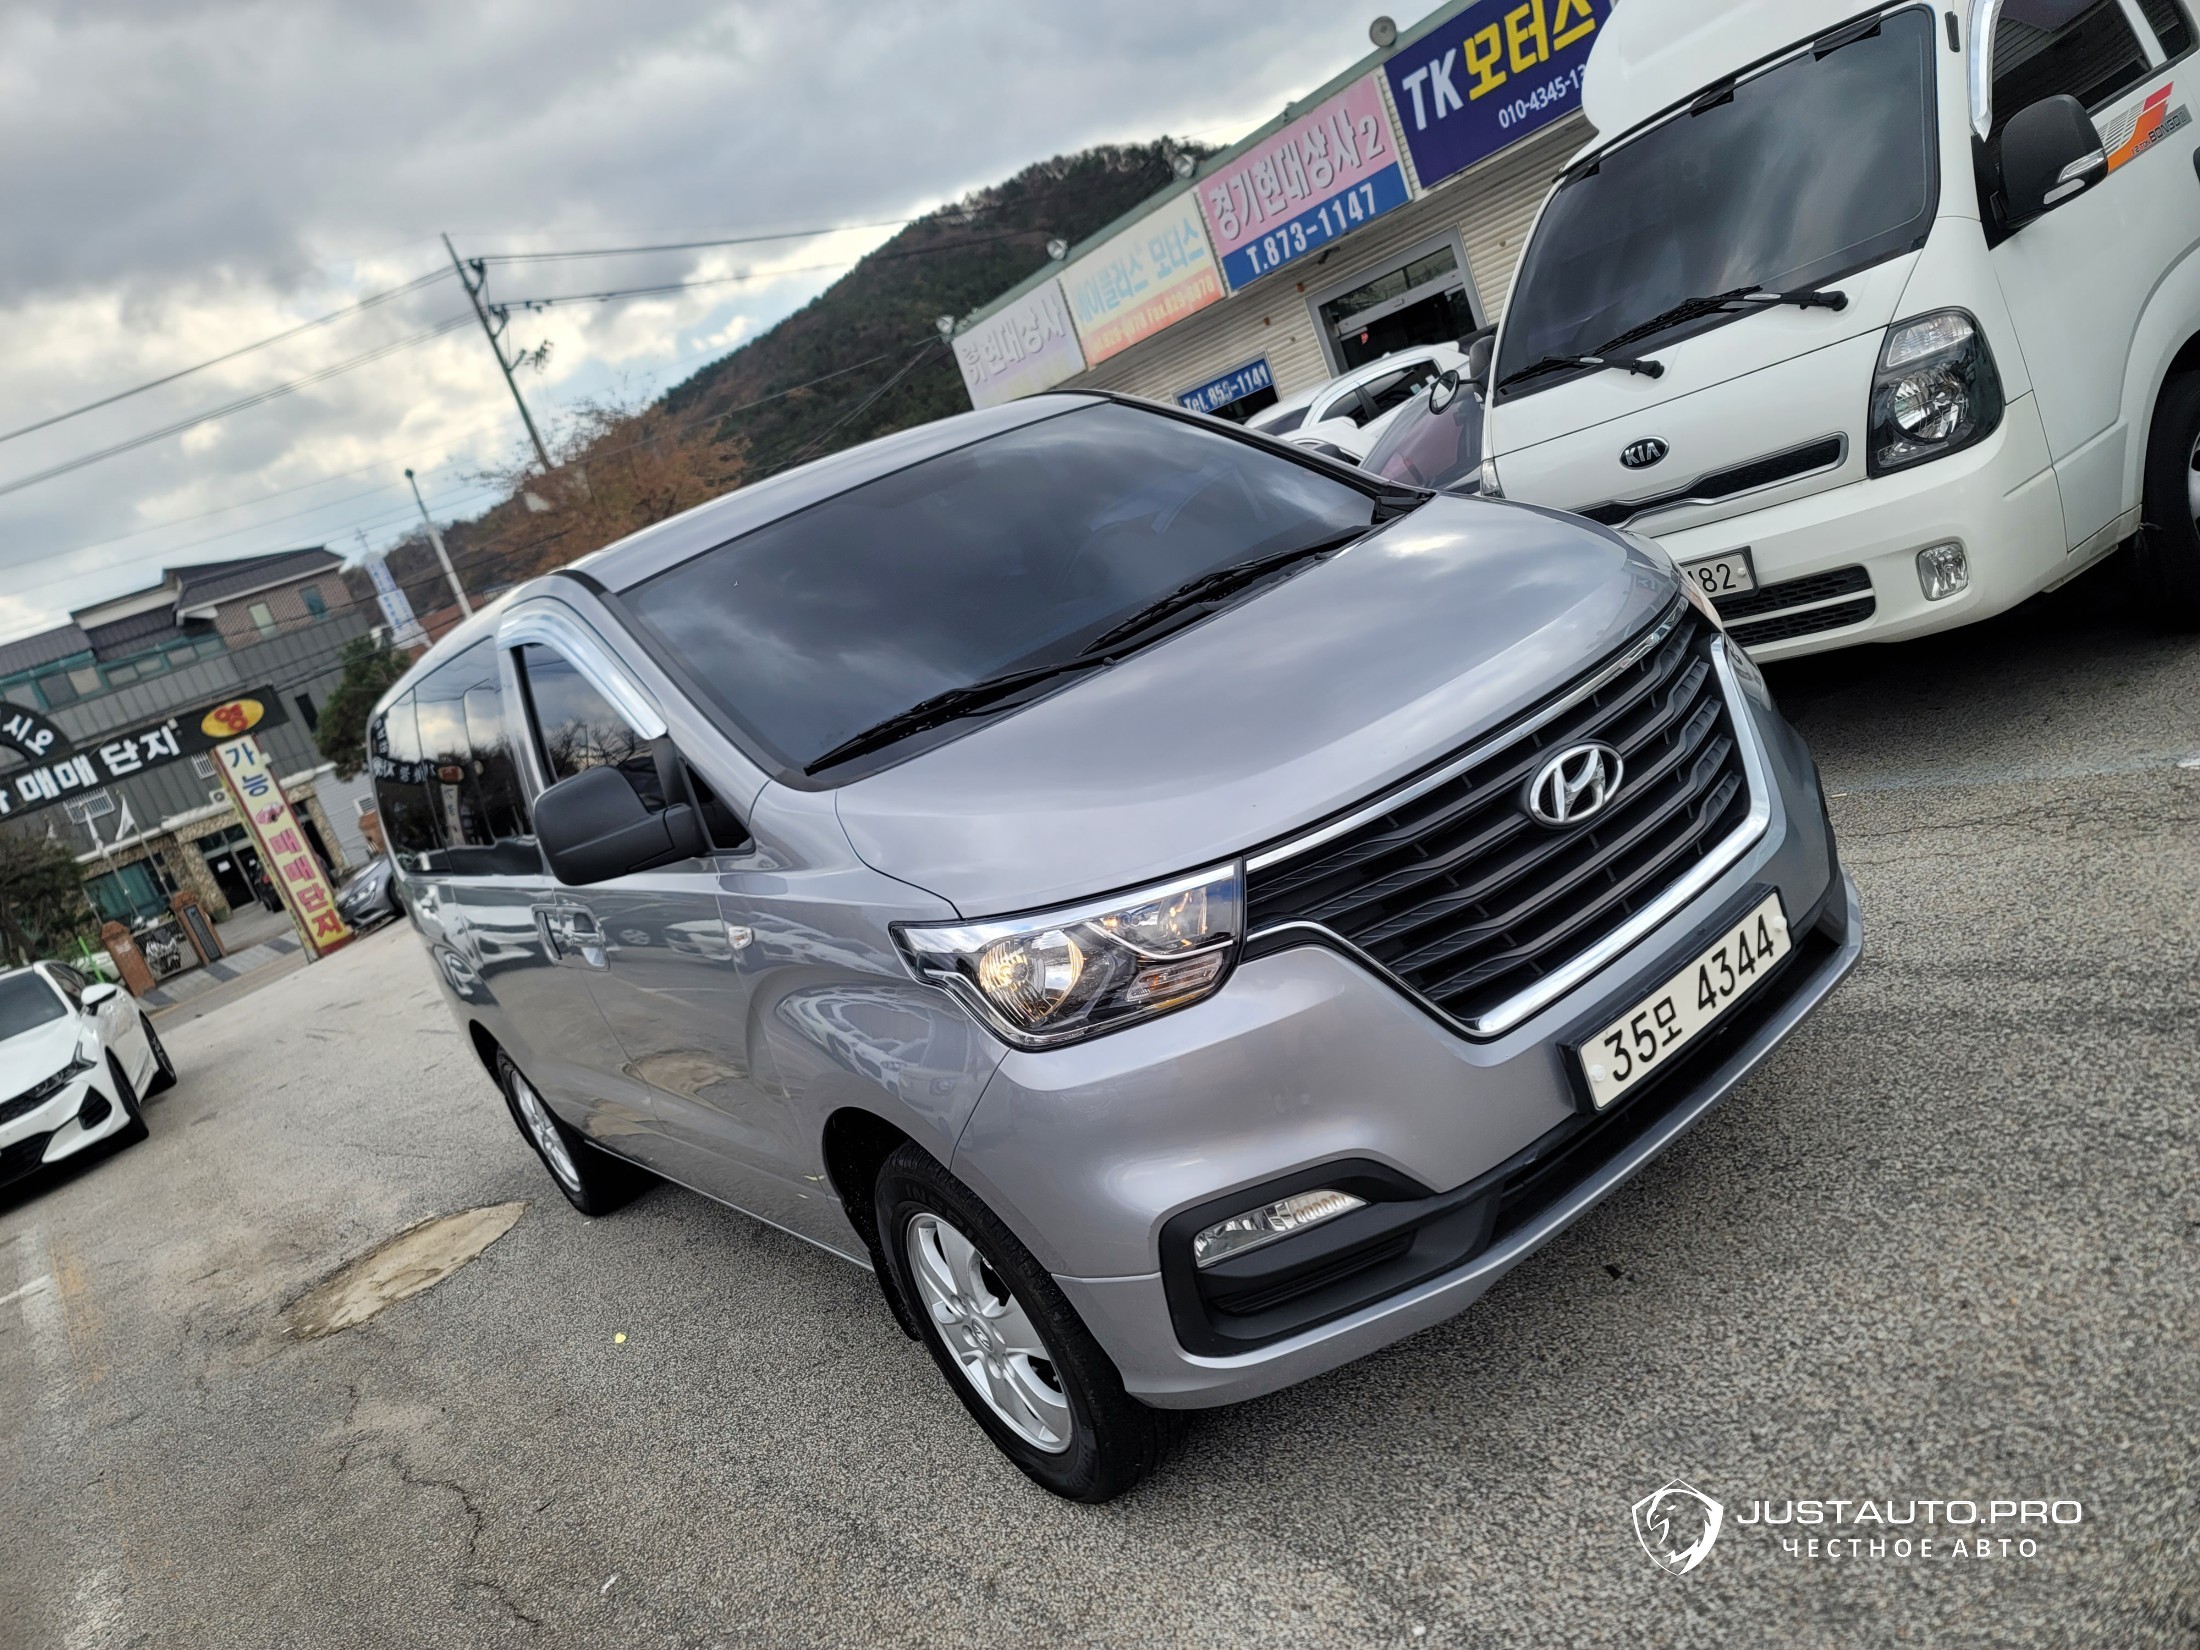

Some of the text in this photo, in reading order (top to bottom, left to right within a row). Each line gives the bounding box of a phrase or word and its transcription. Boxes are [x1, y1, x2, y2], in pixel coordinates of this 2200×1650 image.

[2148, 115, 2180, 143] BONGO
[1245, 182, 1377, 276] T.873-1147
[1625, 441, 1661, 466] KIA
[15, 754, 99, 802] 매매
[99, 725, 181, 777] 단지
[225, 742, 270, 798] 가능
[268, 827, 345, 939] 매매단지
[1604, 913, 1775, 1083] 35모 4344
